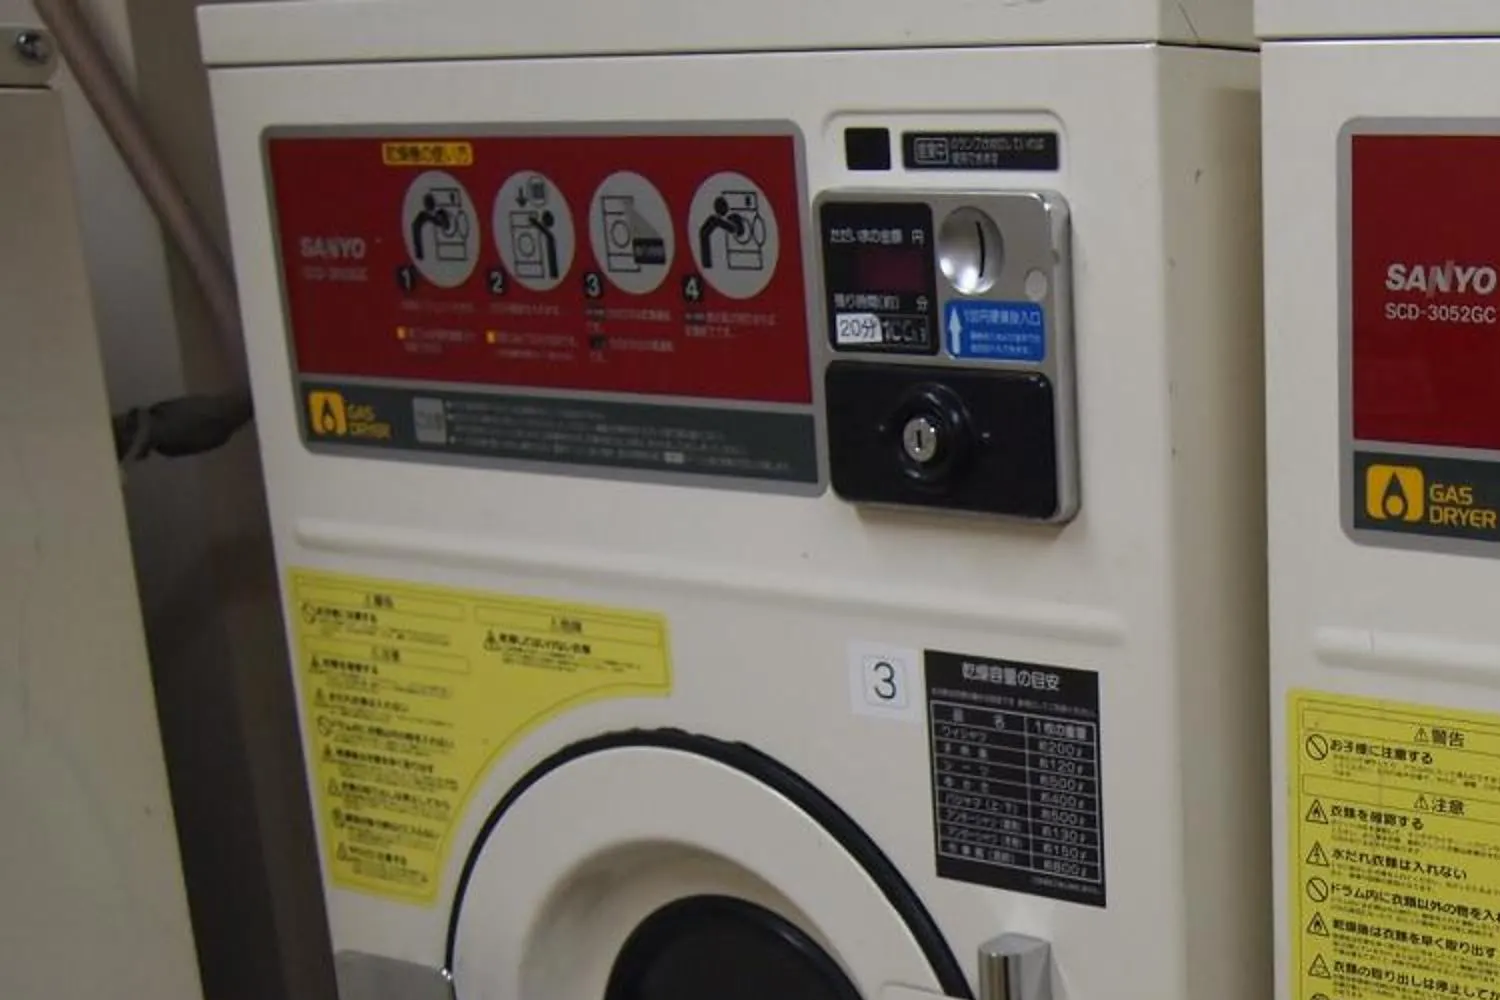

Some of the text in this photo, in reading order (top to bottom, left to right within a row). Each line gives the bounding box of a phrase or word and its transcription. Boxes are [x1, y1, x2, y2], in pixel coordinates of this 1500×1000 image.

[299, 236, 367, 260] SANYO
[400, 267, 412, 289] 1
[489, 270, 504, 294] 2
[587, 273, 602, 297] 3
[684, 275, 701, 300] 4
[1386, 261, 1497, 297] SANYO
[1385, 301, 1496, 325] SCD-3052GC
[840, 320, 876, 339] 20分
[1430, 483, 1473, 507] GAS
[1430, 507, 1496, 529] DRYER
[873, 660, 898, 700] 3
[1431, 728, 1464, 748] 警告
[1330, 738, 1433, 765] お子様に注意する
[1431, 798, 1465, 816] 注意
